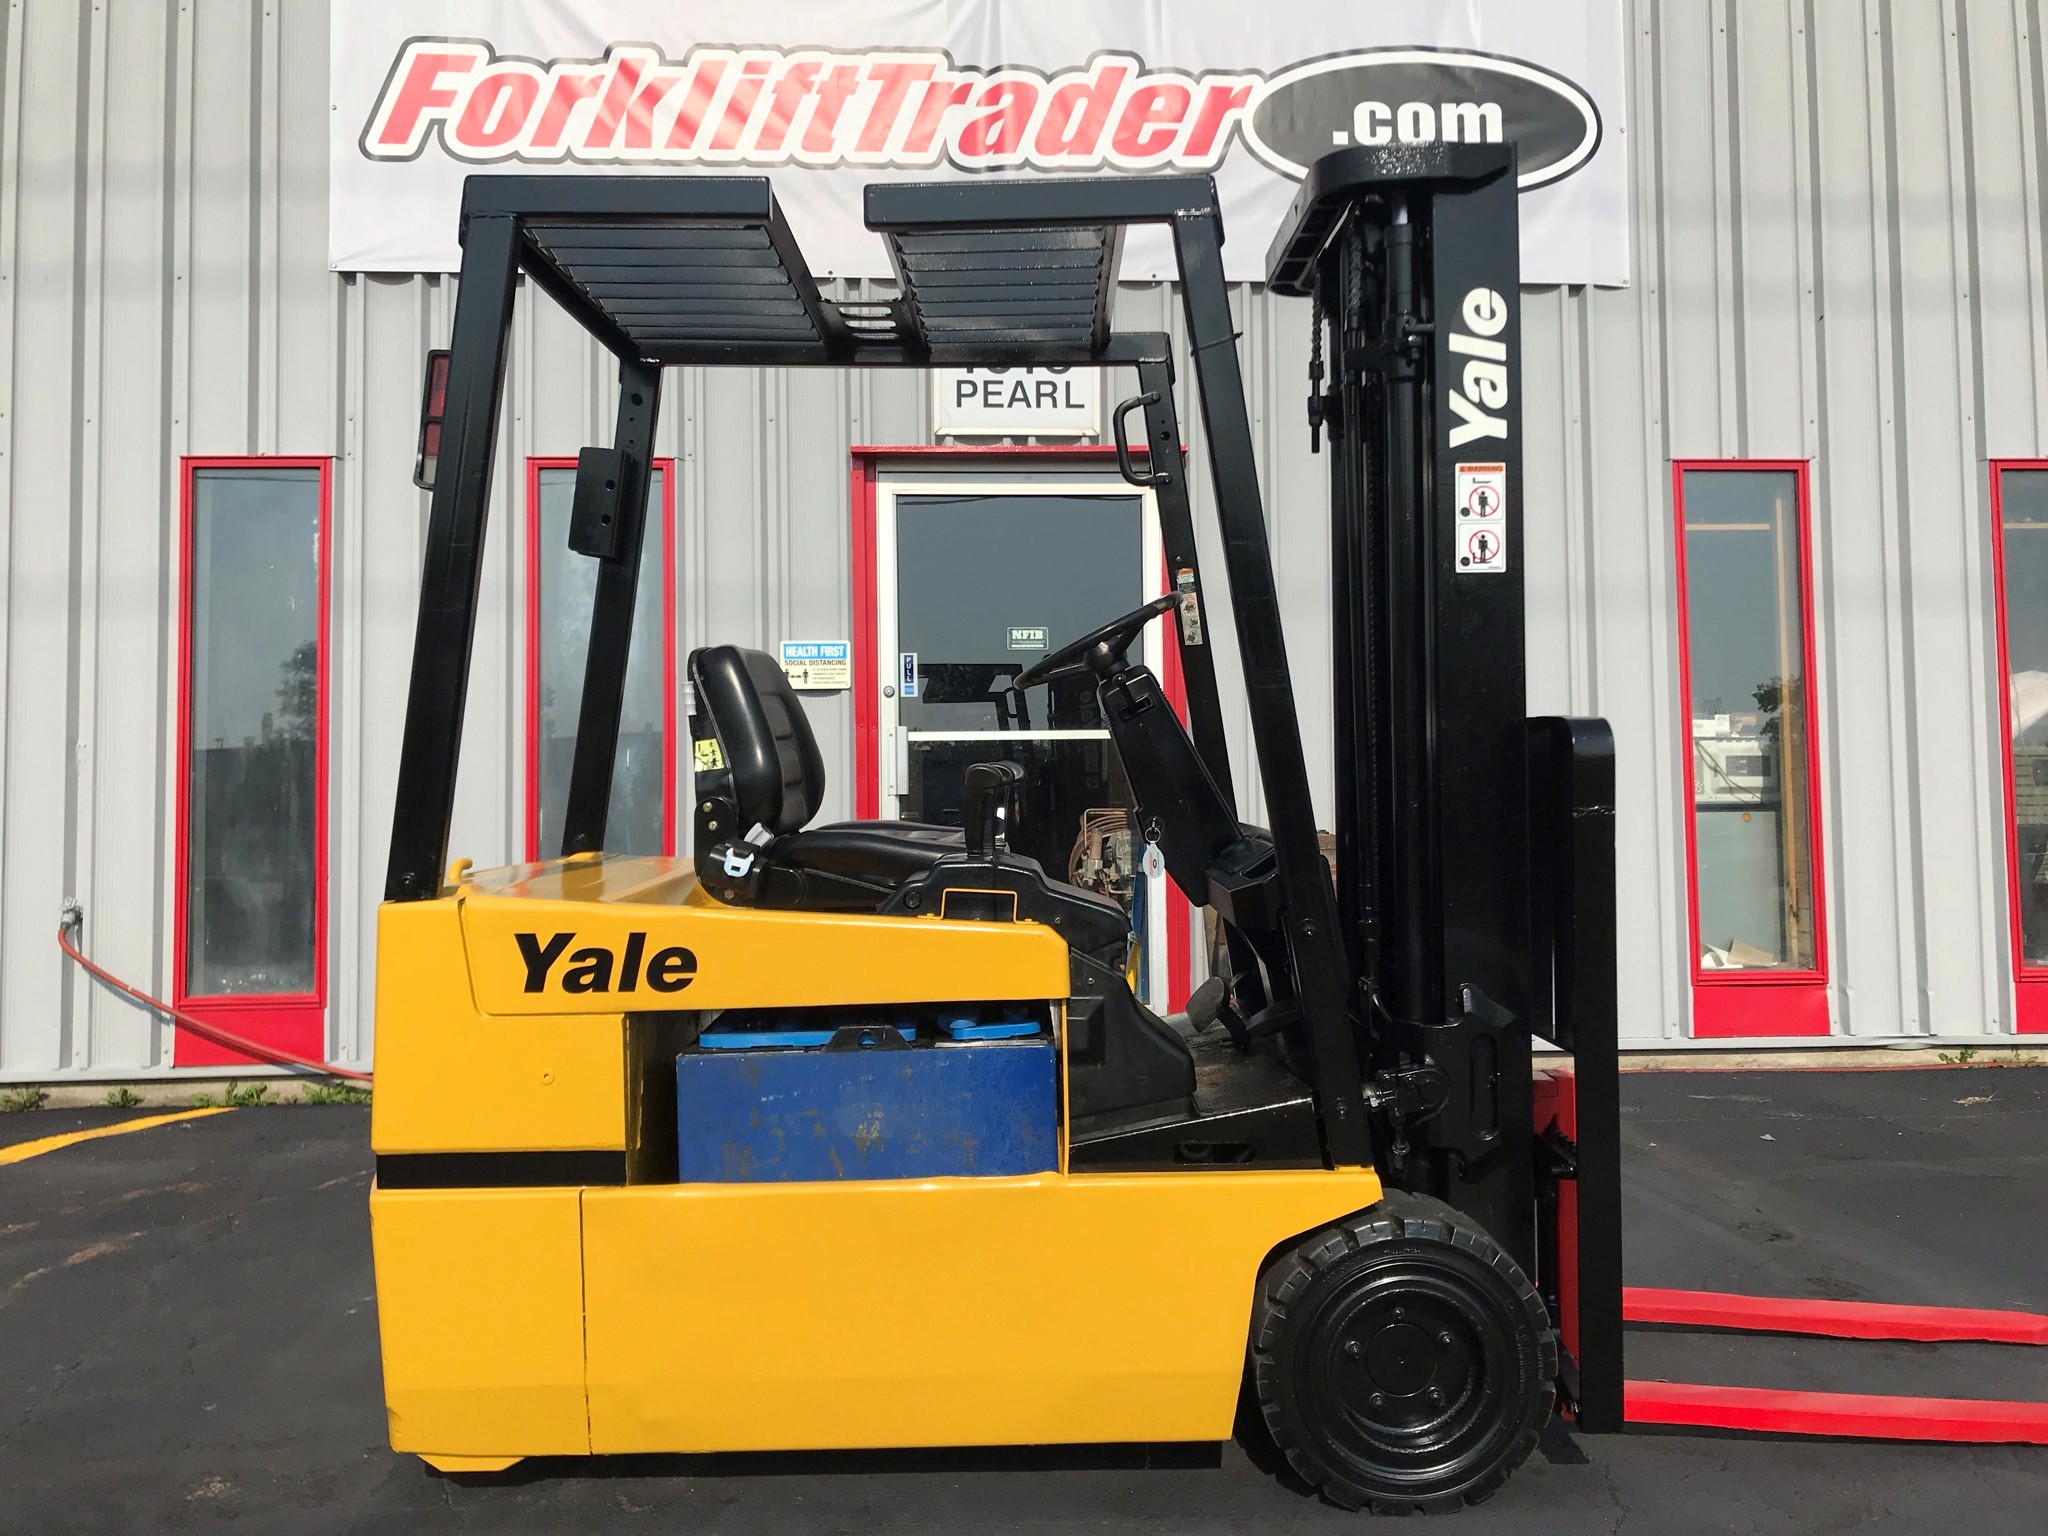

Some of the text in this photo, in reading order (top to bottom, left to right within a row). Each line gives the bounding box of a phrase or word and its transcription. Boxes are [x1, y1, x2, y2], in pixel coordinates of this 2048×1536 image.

[376, 51, 1503, 160] ForkliftTrader .com
[956, 379, 1085, 409] PEARL
[1448, 287, 1509, 448] Yale
[785, 645, 845, 657] HEALTH FIRST
[513, 932, 698, 994] Yale
